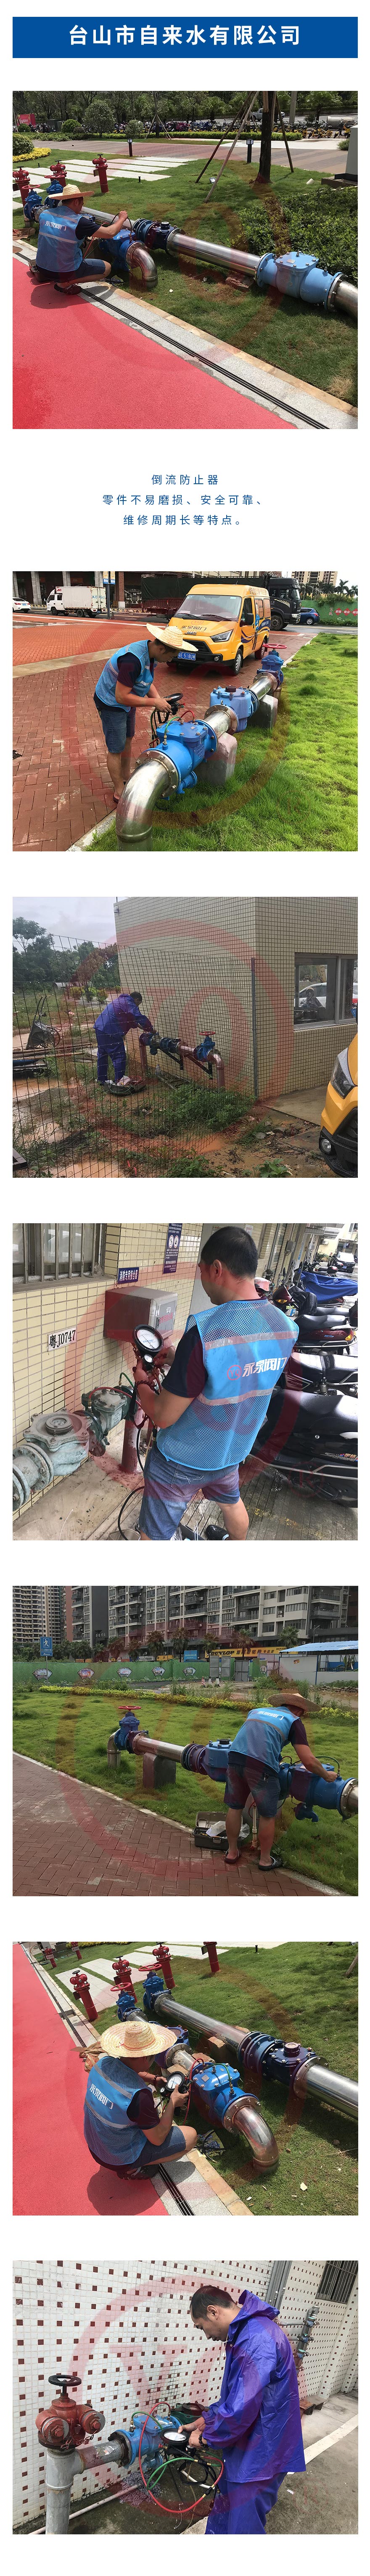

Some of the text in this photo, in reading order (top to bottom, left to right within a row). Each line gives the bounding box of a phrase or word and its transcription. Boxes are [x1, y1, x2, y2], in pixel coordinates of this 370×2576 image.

[45, 221, 66, 231] 永泉阀门
[119, 1269, 138, 1281] 消防专用接合器
[49, 1330, 76, 1349] 粤J0747
[230, 1357, 288, 1378] YQ 永泉阀门
[90, 2083, 114, 2110] 永泉阀门
